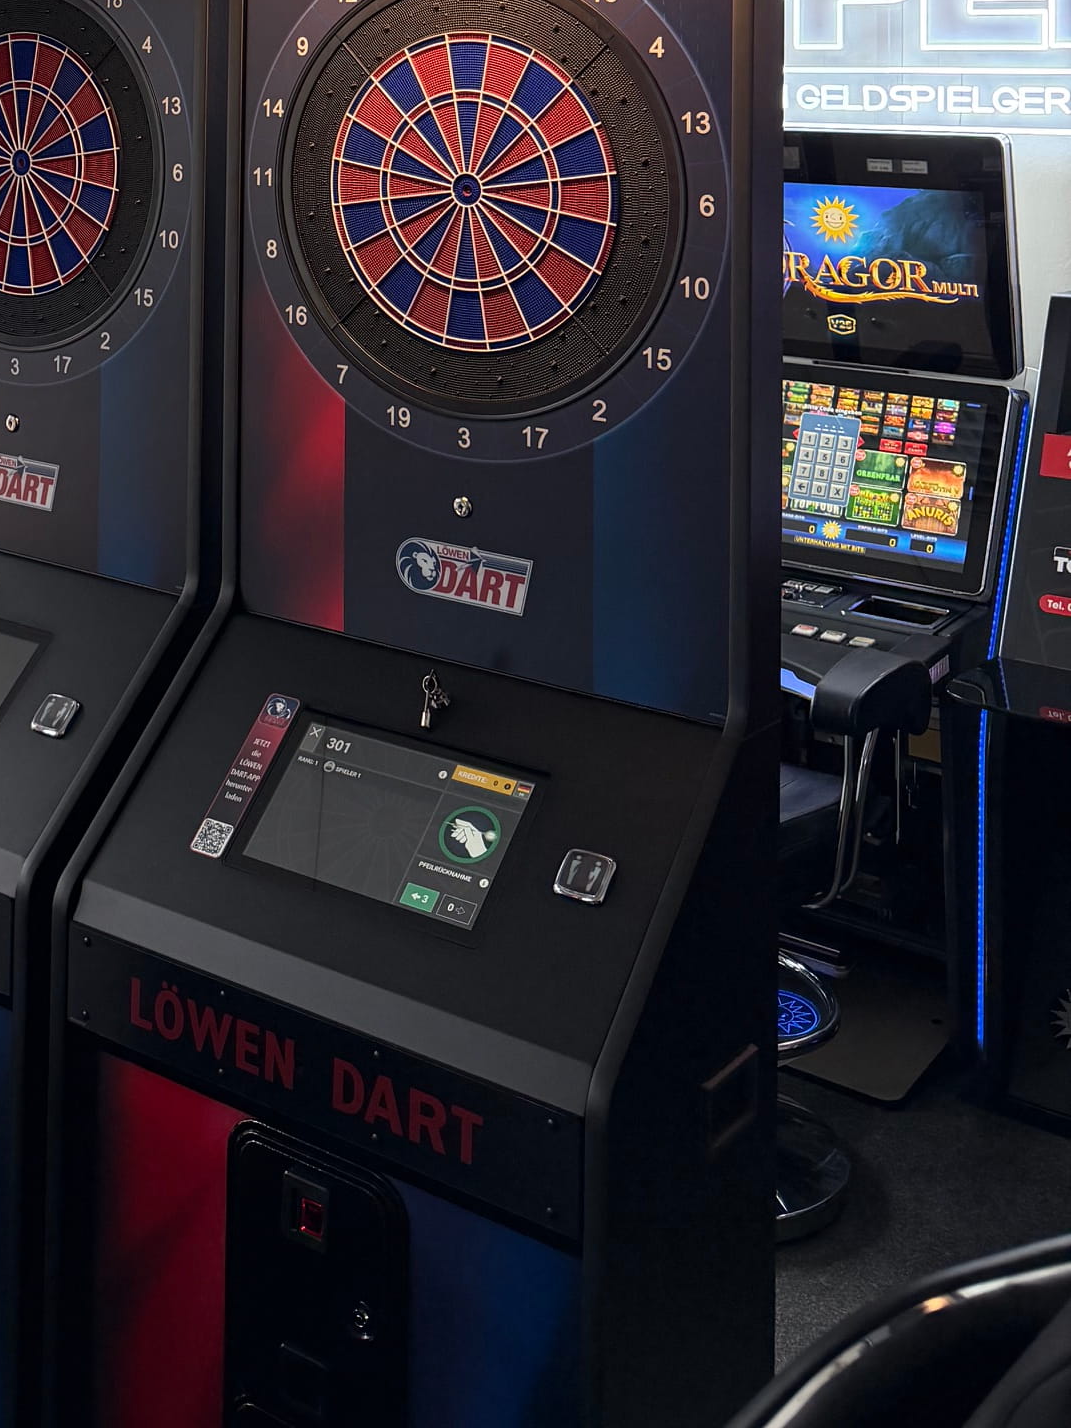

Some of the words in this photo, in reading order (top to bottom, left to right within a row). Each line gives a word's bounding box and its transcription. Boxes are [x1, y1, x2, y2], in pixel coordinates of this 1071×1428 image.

[141, 35, 153, 54] 4
[296, 36, 309, 56] 9
[648, 36, 665, 58] 4
[161, 96, 182, 115] 13
[262, 98, 285, 118] 14
[681, 111, 711, 134] 13
[172, 163, 183, 182] 6
[253, 167, 272, 187] 11
[699, 194, 715, 217] 6
[159, 229, 179, 249] 10
[266, 239, 278, 259] 8
[784, 251, 932, 293] RAGOR
[931, 280, 980, 298] MULTI
[134, 287, 154, 307] 15
[680, 275, 710, 300] 10
[285, 304, 307, 326] 16
[100, 331, 111, 350] 2
[10, 357, 20, 376] 3
[53, 355, 72, 374] 17
[642, 346, 672, 371] 15
[336, 364, 349, 384] 7
[386, 405, 411, 428] 19
[592, 399, 607, 422] 2
[457, 427, 471, 449] 3
[522, 426, 549, 449] 17
[824, 437, 830, 445] 2
[842, 439, 848, 448] 3
[803, 451, 809, 459] 4
[822, 453, 828, 461] 5
[840, 456, 846, 464] 6
[819, 469, 825, 477] 8
[837, 472, 843, 480] 9
[856, 469, 901, 483] GREENFEAR
[816, 485, 822, 494] 0
[905, 506, 955, 526] ANURIS
[808, 524, 816, 534] 0
[889, 538, 896, 547] 0
[926, 544, 934, 554] 0
[436, 545, 469, 561] LÖWEN
[432, 559, 526, 608] DART
[1047, 599, 1065, 611] Tel.
[326, 737, 352, 754] 301
[239, 757, 263, 771] LÖWEN
[224, 791, 243, 803] laden
[421, 894, 429, 904] 3
[447, 902, 455, 912] 0
[129, 975, 296, 1091] LÖWEN
[331, 1056, 484, 1166] DART
